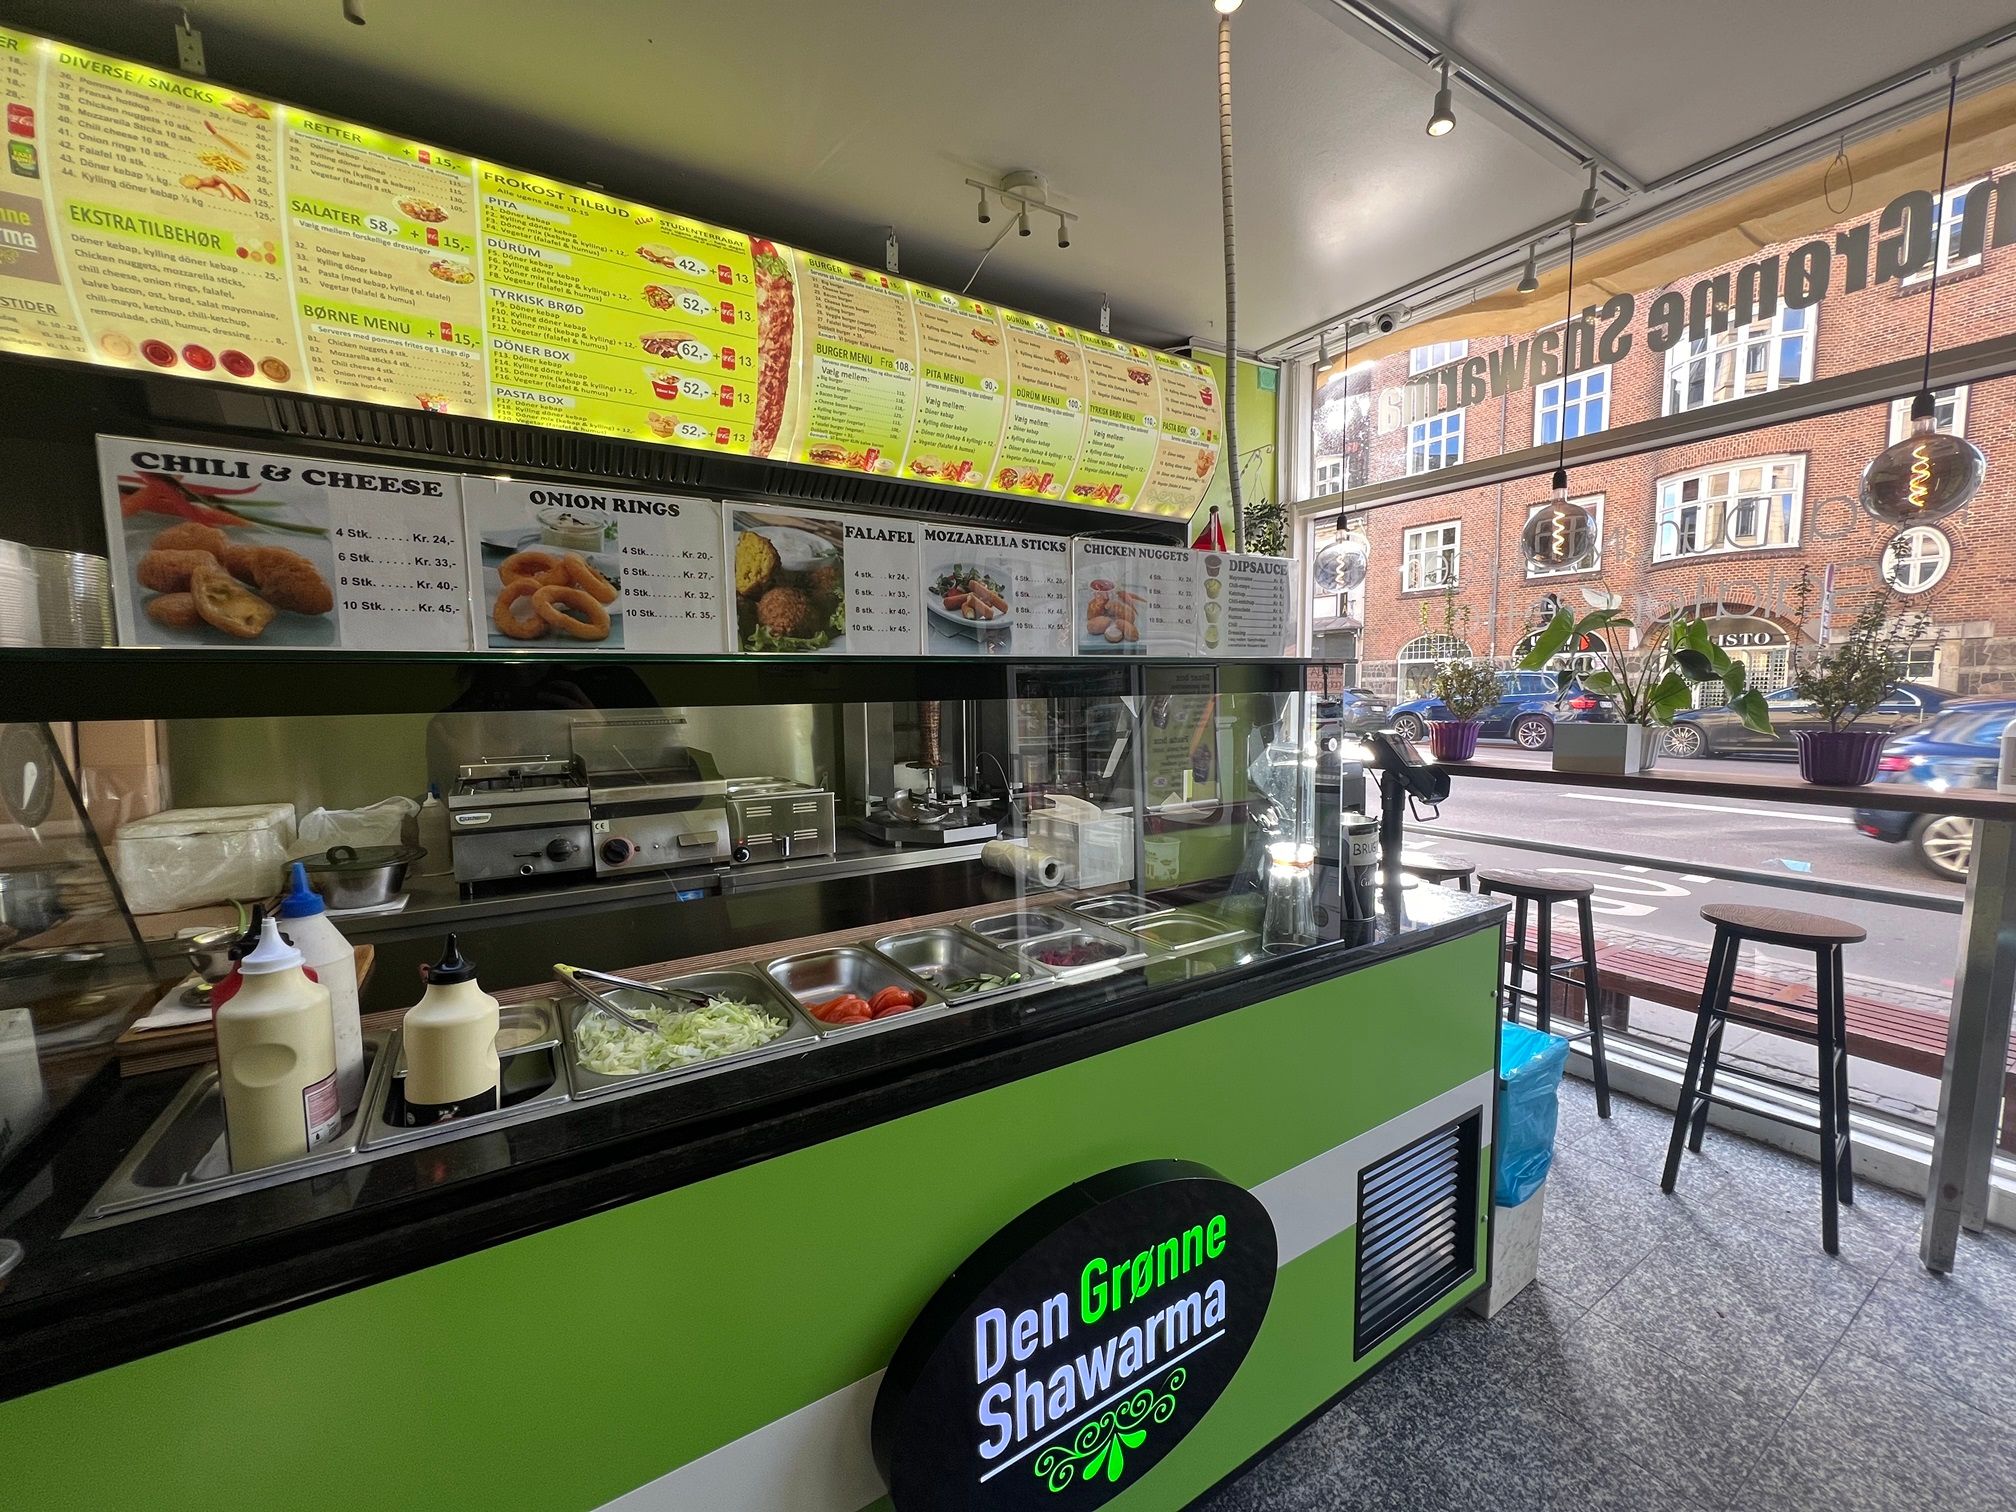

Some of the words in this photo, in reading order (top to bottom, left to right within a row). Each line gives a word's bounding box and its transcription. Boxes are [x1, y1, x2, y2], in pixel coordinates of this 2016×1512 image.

[59, 52, 132, 82] DIVERSE
[149, 77, 214, 104] SNACKS
[304, 120, 362, 143] RETTER
[484, 172, 566, 200] FROKOST
[570, 195, 630, 218] TILBUD
[488, 196, 518, 210] PITA
[292, 200, 361, 226] SALATER
[369, 219, 398, 235] 58,-
[70, 205, 137, 233] EKSTRA
[138, 219, 222, 250] TILBEHØR
[74, 248, 115, 263] Chicken
[487, 238, 541, 258] DÜRÜM
[679, 259, 706, 274] 42,-
[809, 259, 843, 274] BURGER
[490, 287, 544, 306] TYRKISK
[548, 300, 584, 315] BRØD
[915, 289, 932, 300] PITA
[683, 297, 709, 314] 52,-
[304, 304, 359, 325] BØRNE
[364, 316, 411, 334] MENU
[455, 333, 480, 348] 15,-
[493, 338, 540, 356] DÖNER
[544, 351, 570, 361] BOX
[682, 343, 708, 360] 62,-
[816, 344, 848, 360] BURGER
[850, 351, 873, 364] MENU
[880, 357, 893, 368] Fra
[895, 361, 914, 374] 108,-
[821, 366, 839, 377] Vælg
[926, 369, 942, 380] PITA
[943, 373, 964, 384] MENU
[496, 388, 535, 400] PASTA
[538, 395, 564, 405] BOX
[683, 381, 708, 398] 52,-
[1016, 388, 1040, 401] DÜRÜM
[1041, 395, 1060, 406] MENU
[681, 425, 706, 437] 52,-
[131, 452, 250, 478] CHILI
[260, 464, 291, 481] &
[302, 469, 443, 497] CHEESE
[529, 490, 606, 510] ONION
[612, 498, 680, 517] RINGS
[336, 528, 343, 536] 4
[348, 529, 372, 539] Stk.
[413, 534, 429, 543] Kr.
[433, 535, 454, 545] 24,-
[845, 526, 915, 543] FALAFEL
[925, 529, 1018, 548] MOZZARELLA
[1021, 538, 1067, 552] STICKS
[338, 553, 346, 561] 6
[350, 553, 374, 563] Stk.
[415, 557, 431, 566] Kr.
[435, 559, 456, 568] 33,-
[631, 547, 649, 556] Stk.
[697, 552, 713, 560] 20,-
[1084, 543, 1136, 558] CHICKEN
[1138, 550, 1189, 562] NUGGETS
[624, 567, 629, 575] 6
[632, 568, 650, 576] Stk.
[683, 571, 695, 579] Kr.
[698, 572, 714, 580] 27,-
[1229, 560, 1288, 575] DIPSAUCE
[341, 577, 348, 585] 8
[352, 577, 376, 587] Stk.
[417, 580, 433, 589] Kr.
[437, 582, 458, 591] 40,-
[633, 589, 651, 597] Stk.
[684, 591, 696, 599] Kr.
[699, 592, 715, 600] 32,-
[343, 601, 357, 610] 10
[362, 602, 385, 611] Stk.
[419, 604, 435, 612] Kr.
[438, 605, 460, 614] 45,-
[626, 609, 636, 617] 10
[640, 609, 657, 617] Stk.
[700, 612, 716, 620] 35,-
[1708, 632, 1771, 646] ISTO
[976, 1292, 1069, 1384] Den
[1081, 1214, 1227, 1324] Grønne
[978, 1279, 1226, 1460] Shawarma
